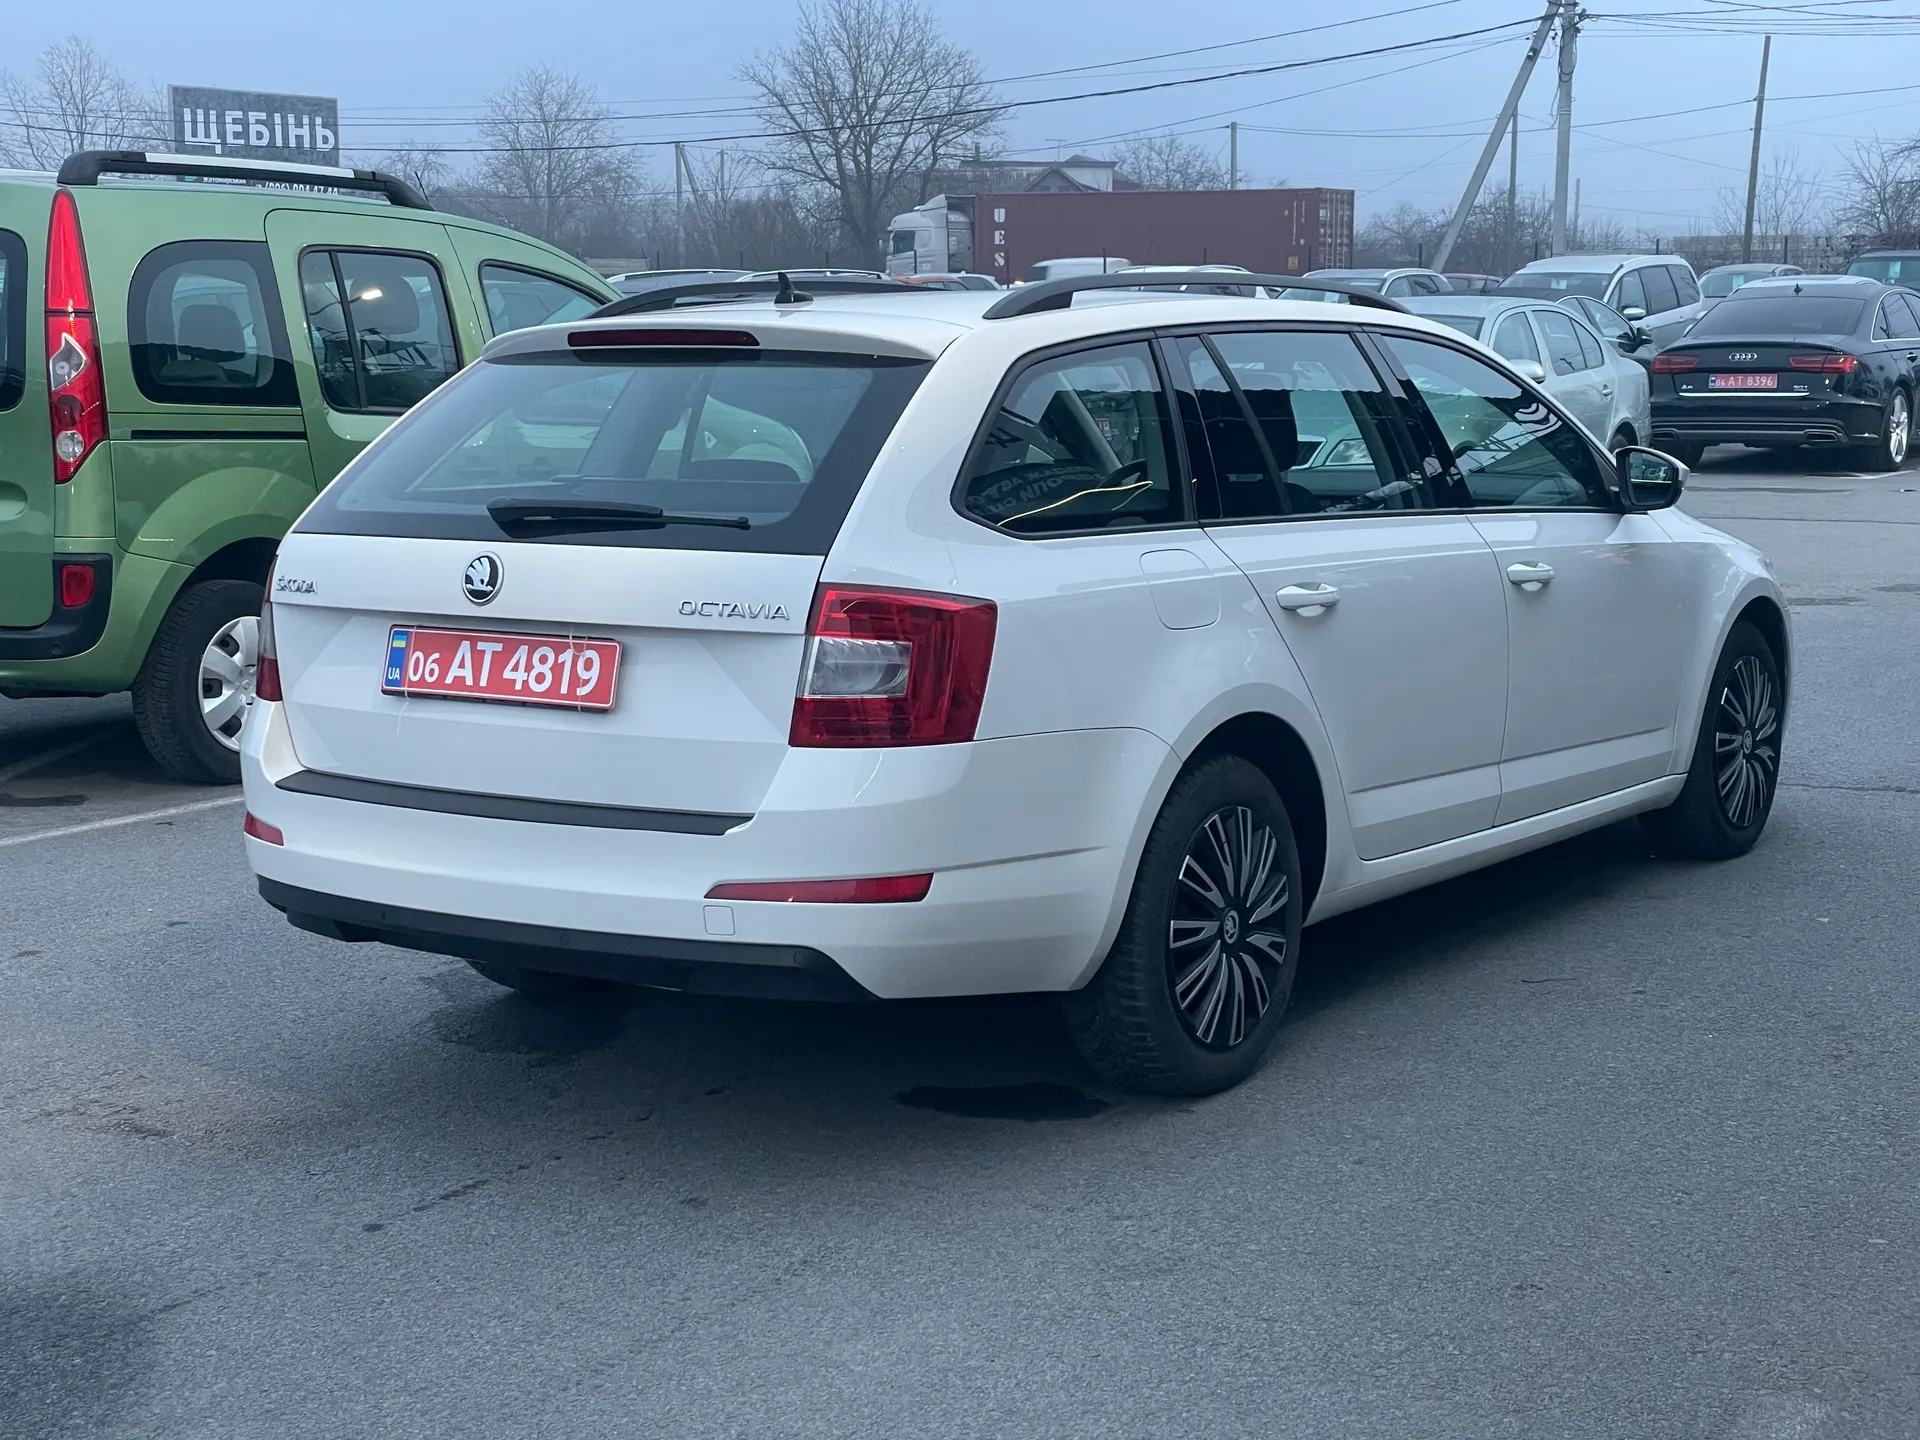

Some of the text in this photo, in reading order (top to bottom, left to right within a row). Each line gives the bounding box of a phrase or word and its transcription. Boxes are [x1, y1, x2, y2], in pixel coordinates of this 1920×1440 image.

[183, 107, 335, 154] ЩЕБІНЬ
[1728, 376, 1744, 386] AT
[1747, 376, 1773, 387] 8396
[679, 600, 790, 620] OCTAVIA
[387, 640, 601, 696] UA 06 AT 4819
